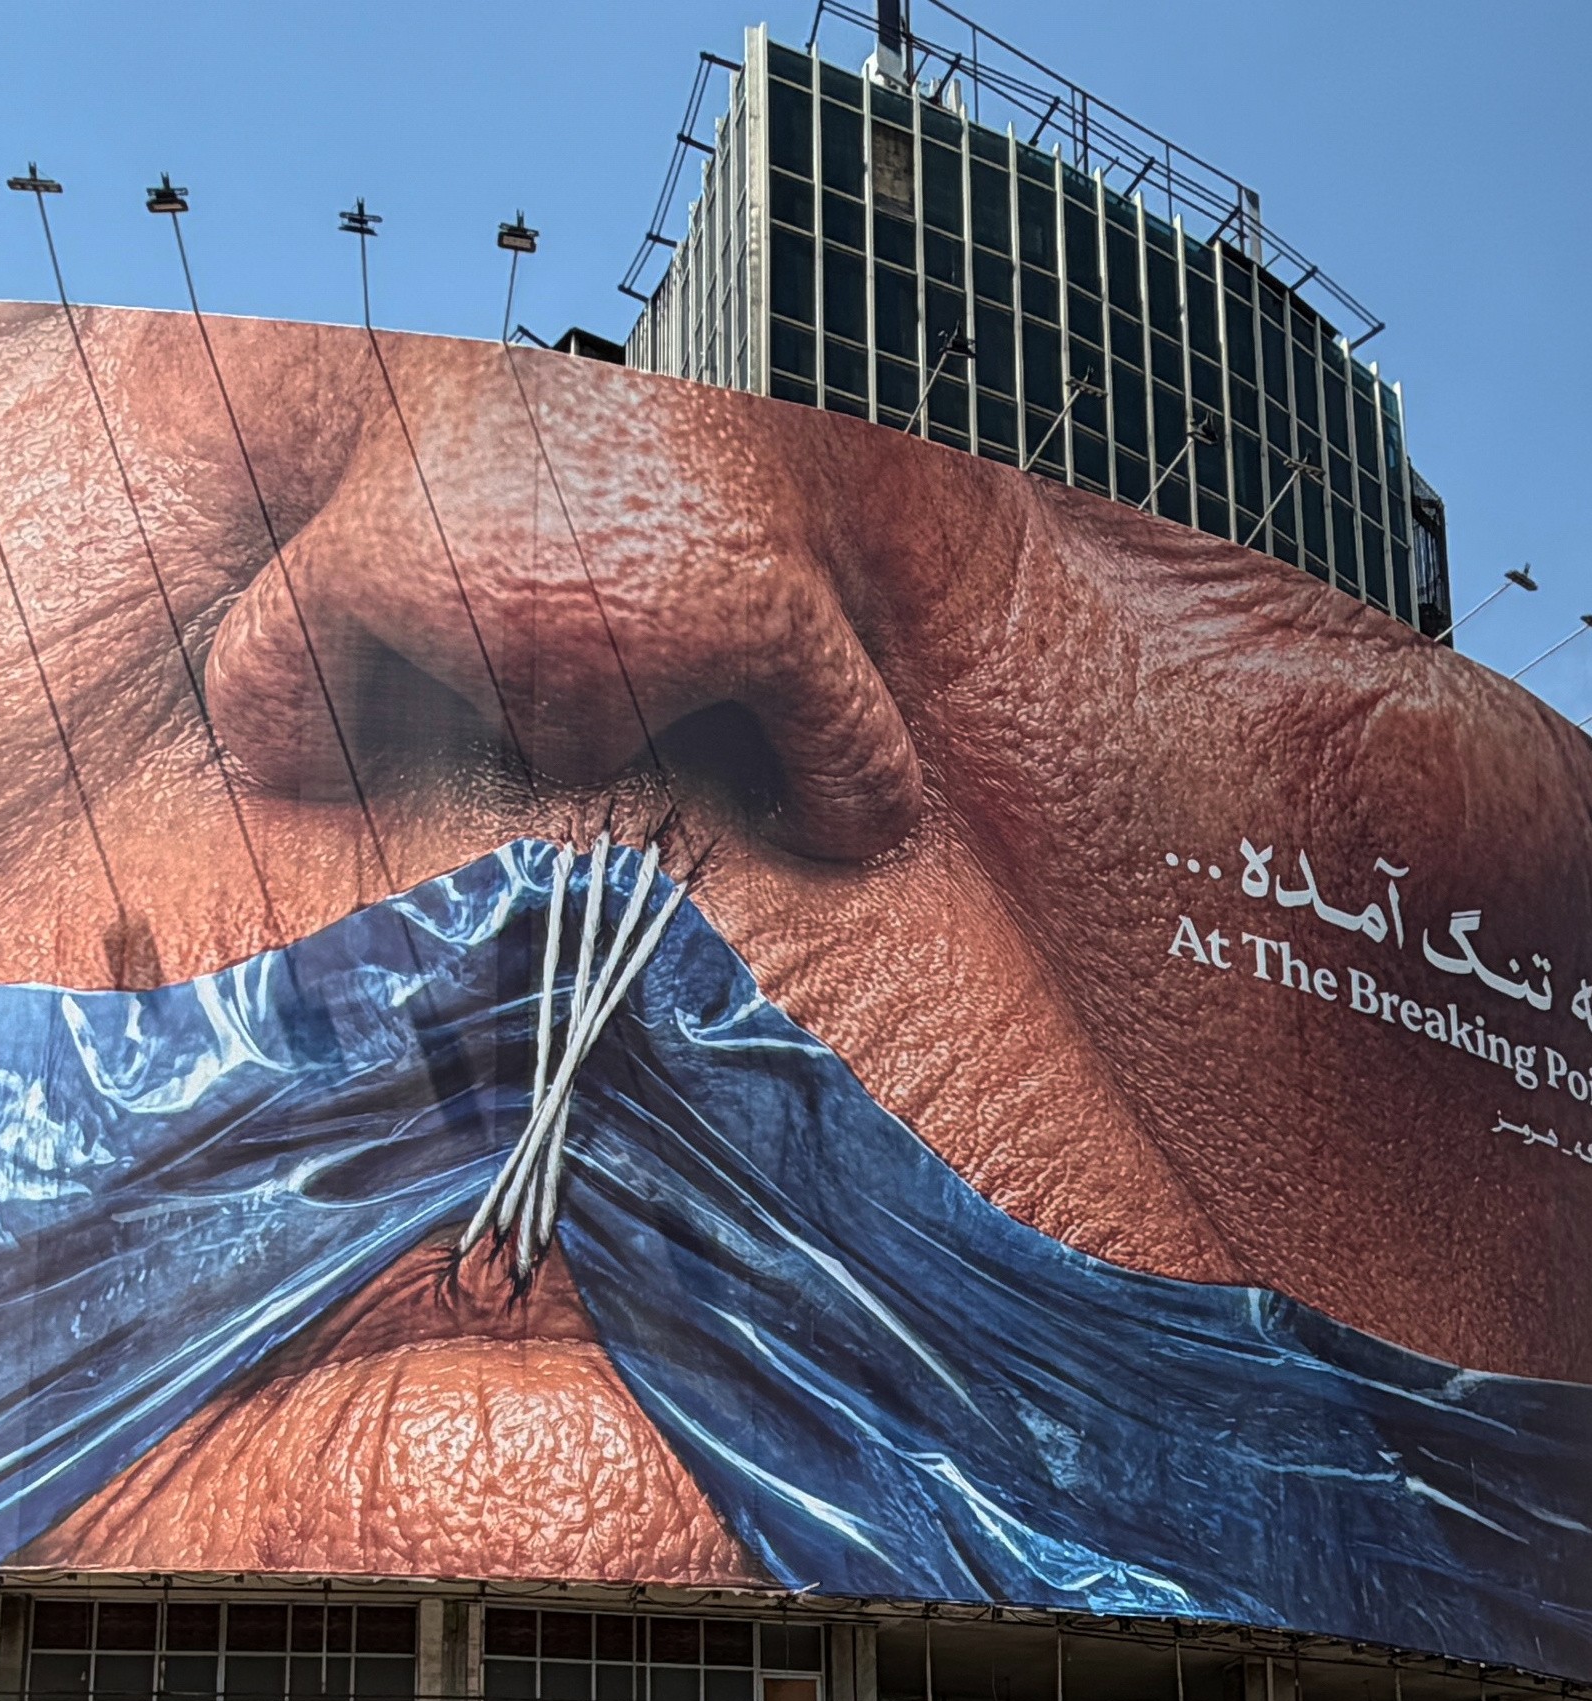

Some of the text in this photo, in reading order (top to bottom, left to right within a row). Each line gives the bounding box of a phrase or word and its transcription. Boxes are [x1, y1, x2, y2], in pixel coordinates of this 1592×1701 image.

[1167, 914, 1233, 970] At
[1241, 931, 1339, 1001] The
[1347, 956, 1539, 1091] Breaking
[1422, 911, 1553, 1012] تنگ
